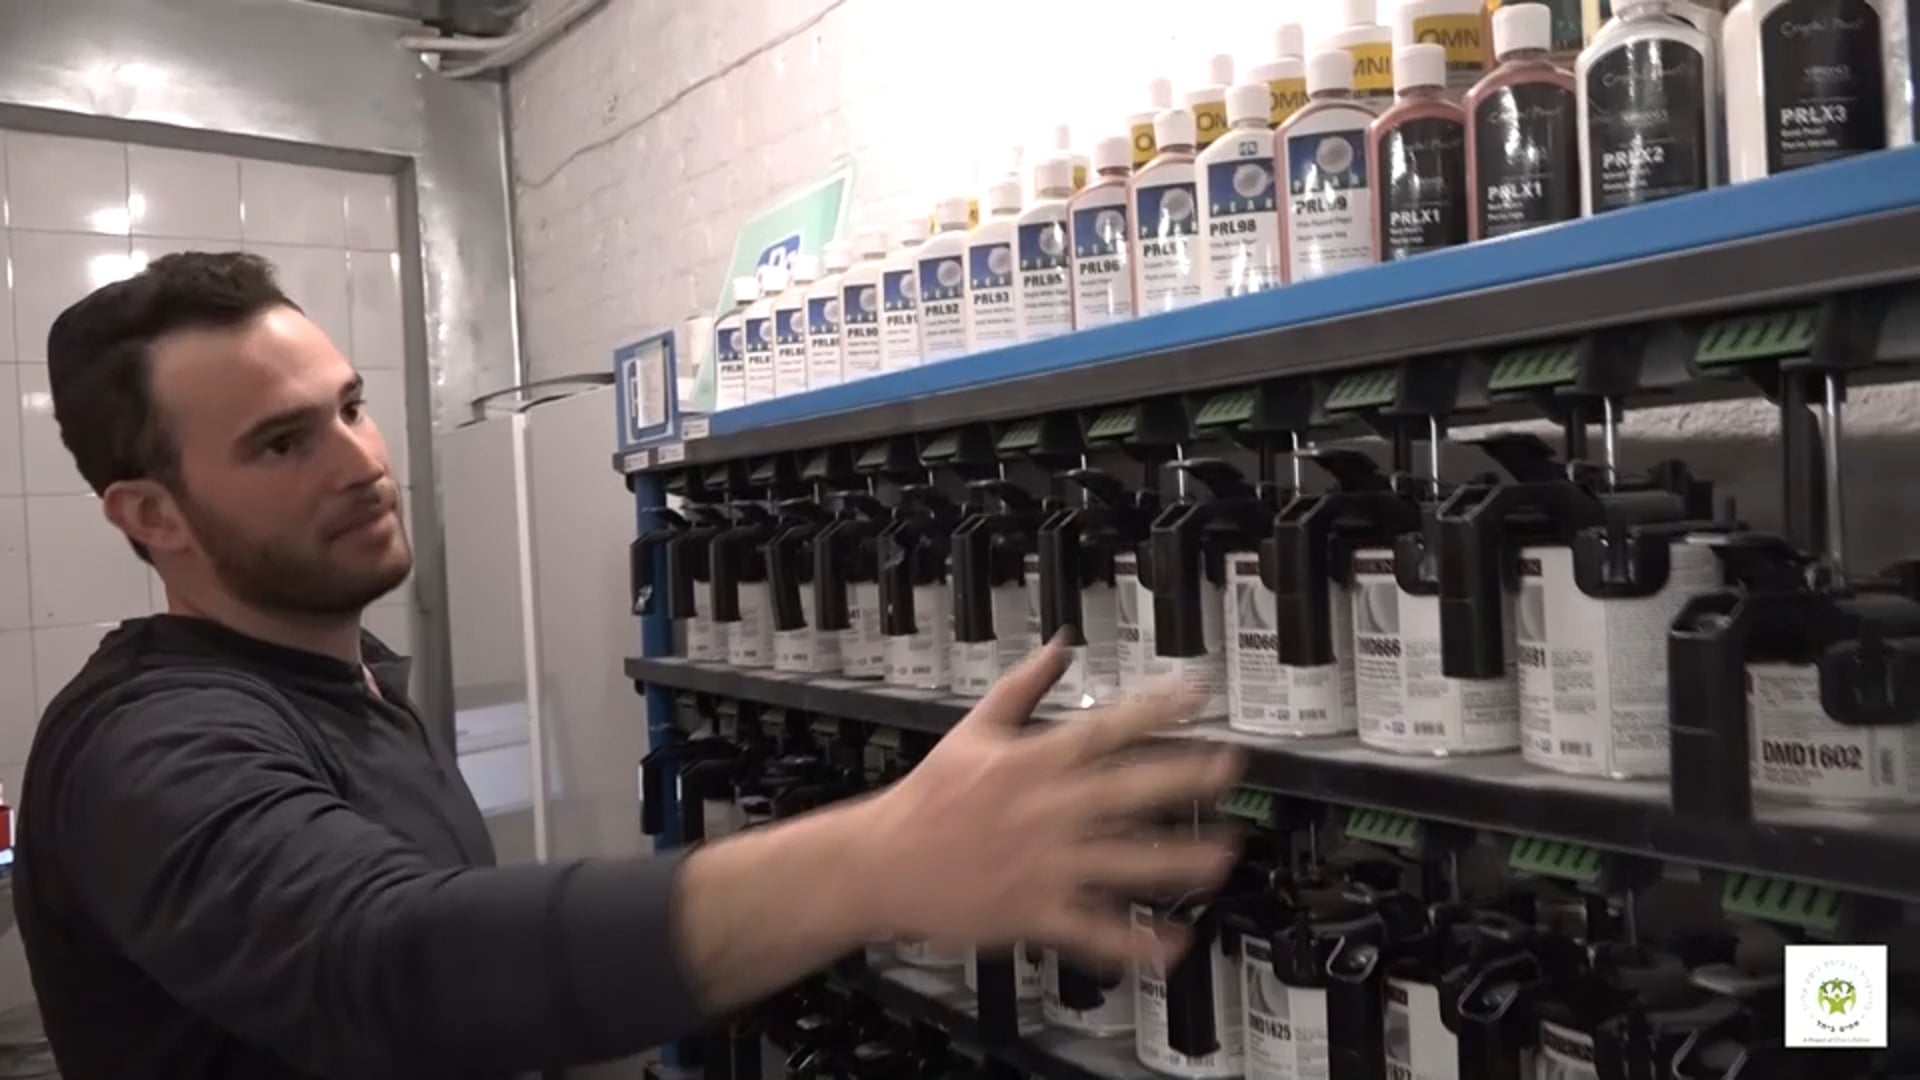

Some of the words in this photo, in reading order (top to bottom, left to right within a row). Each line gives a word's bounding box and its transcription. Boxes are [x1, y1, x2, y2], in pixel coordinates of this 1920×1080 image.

[1780, 105, 1848, 125] PRLX3
[1390, 208, 1441, 225] PRLX1
[1209, 219, 1257, 237] PRL98
[1079, 259, 1121, 276] PRL96
[973, 291, 1009, 305] PRL93
[1762, 739, 1864, 771] DMD1602
